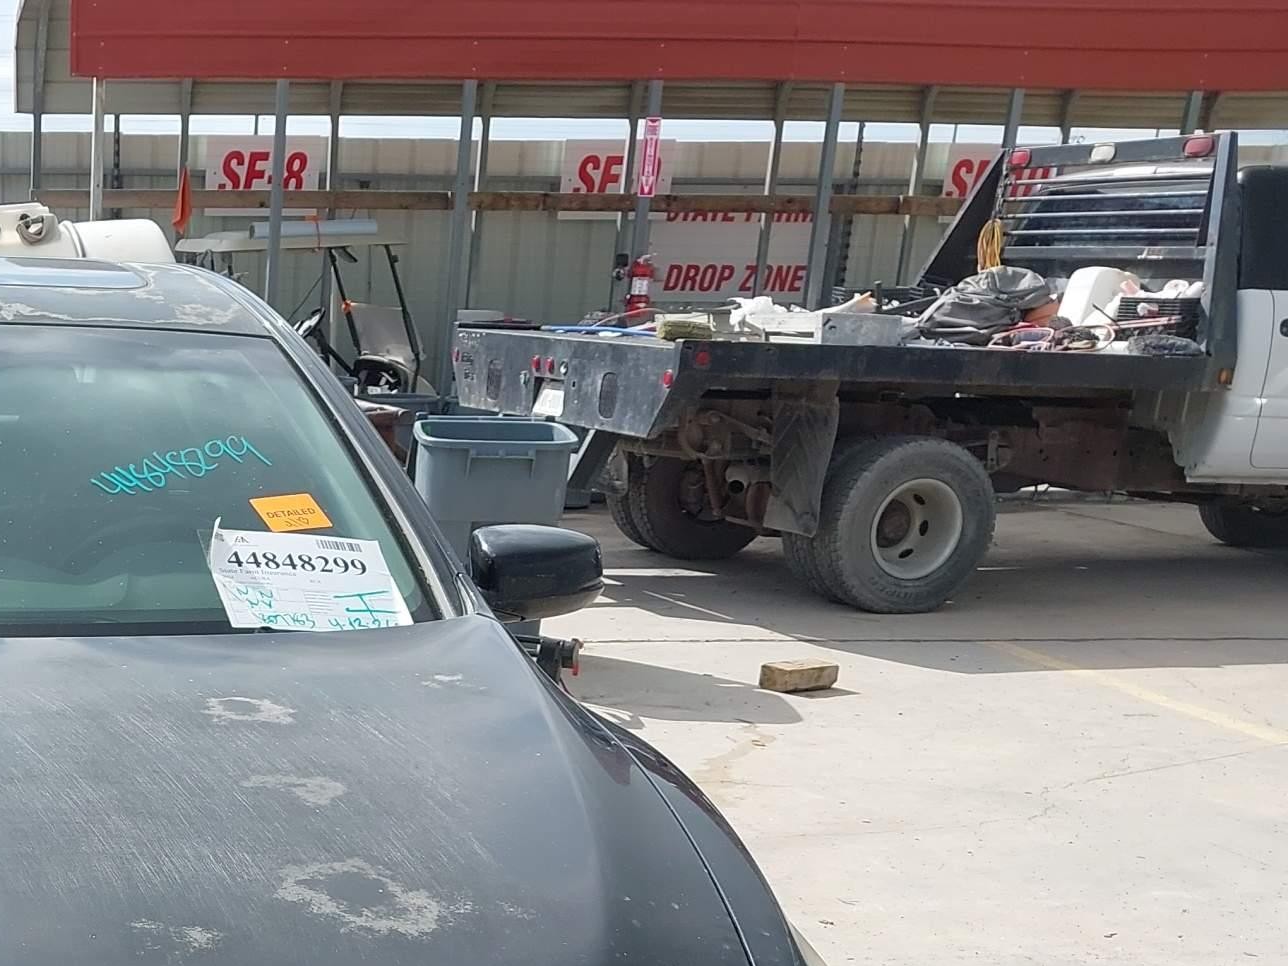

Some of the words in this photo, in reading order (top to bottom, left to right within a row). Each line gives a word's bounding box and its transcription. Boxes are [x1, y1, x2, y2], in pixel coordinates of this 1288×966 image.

[663, 264, 735, 292] DROP
[266, 507, 316, 519] DETAILED
[227, 550, 367, 576] 44848299
